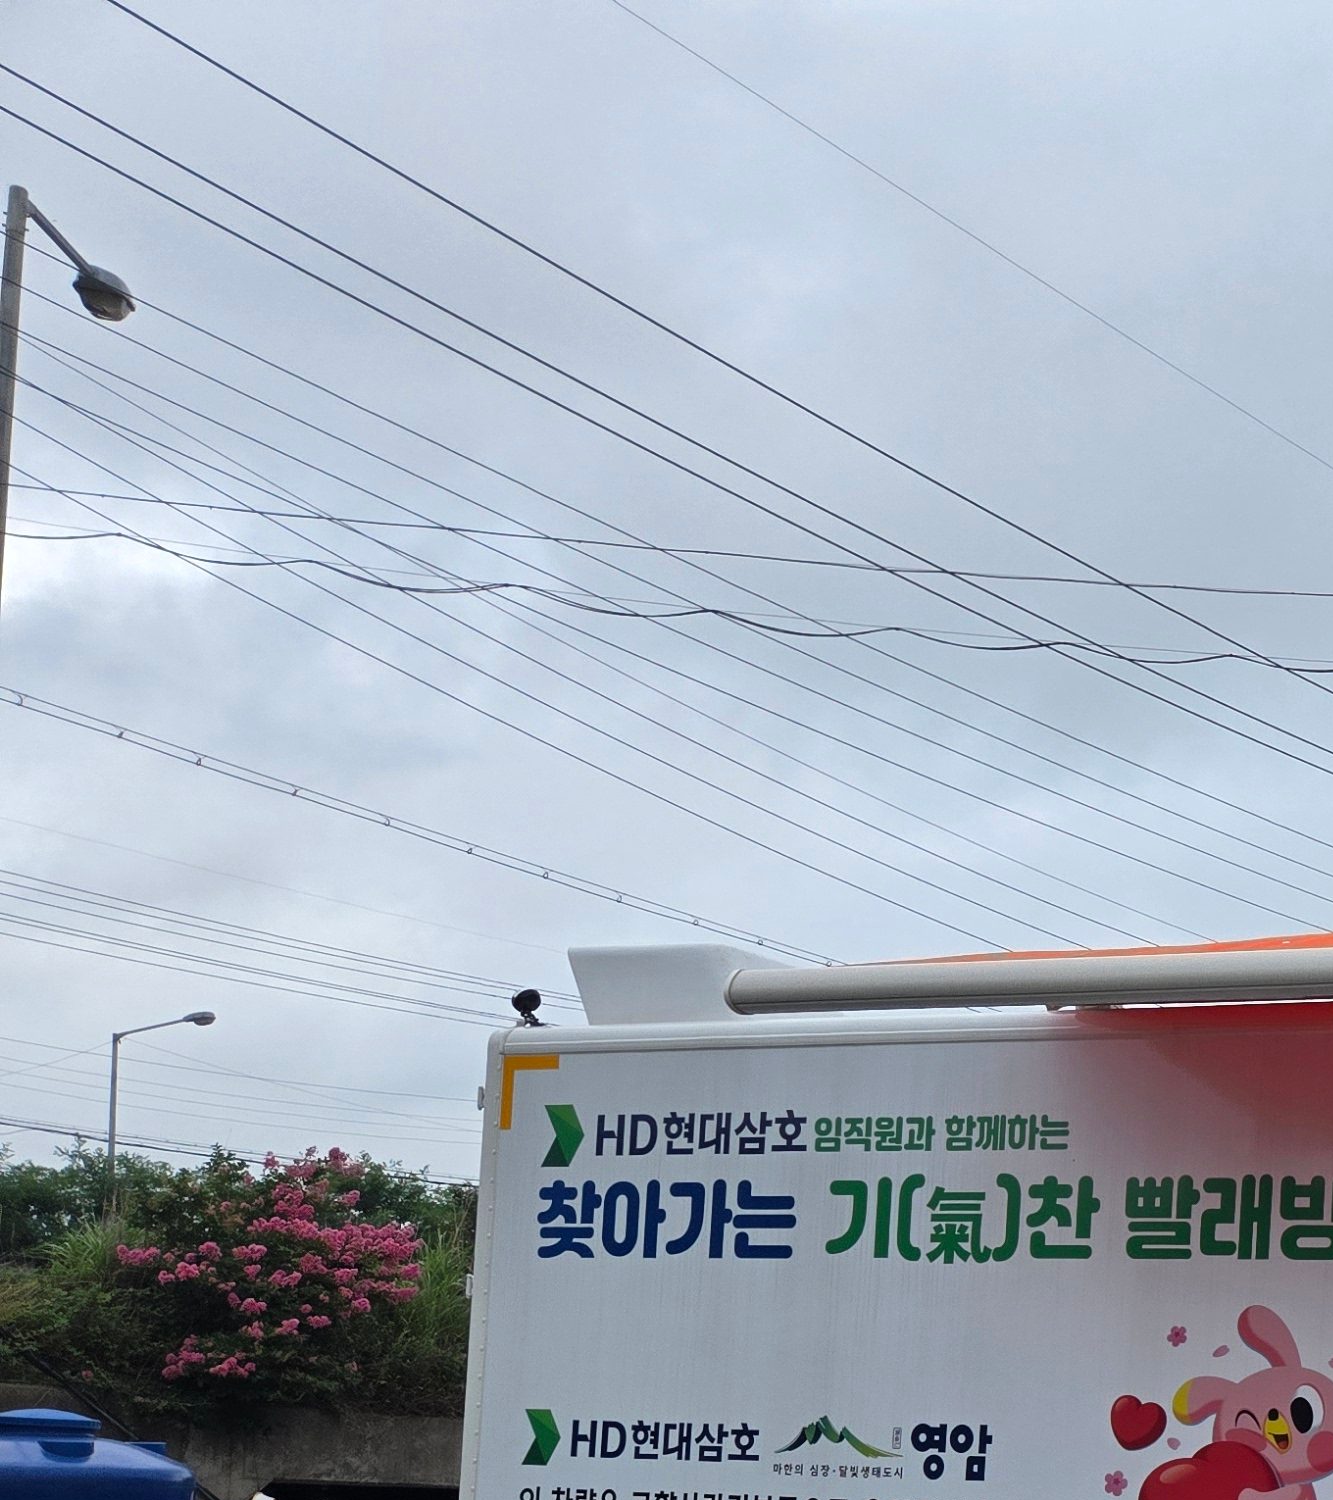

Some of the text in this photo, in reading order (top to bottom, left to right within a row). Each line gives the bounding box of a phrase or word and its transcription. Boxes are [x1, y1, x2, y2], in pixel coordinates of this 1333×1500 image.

[595, 1110, 1070, 1157] HD현대삼호 임직원과 함께하는
[537, 1178, 798, 1259] 찾아가는
[825, 1173, 1101, 1265] 기(氣)찬
[570, 1419, 760, 1463] HD현대삼호
[910, 1423, 993, 1481] 영암
[772, 1463, 804, 1476] 마한의
